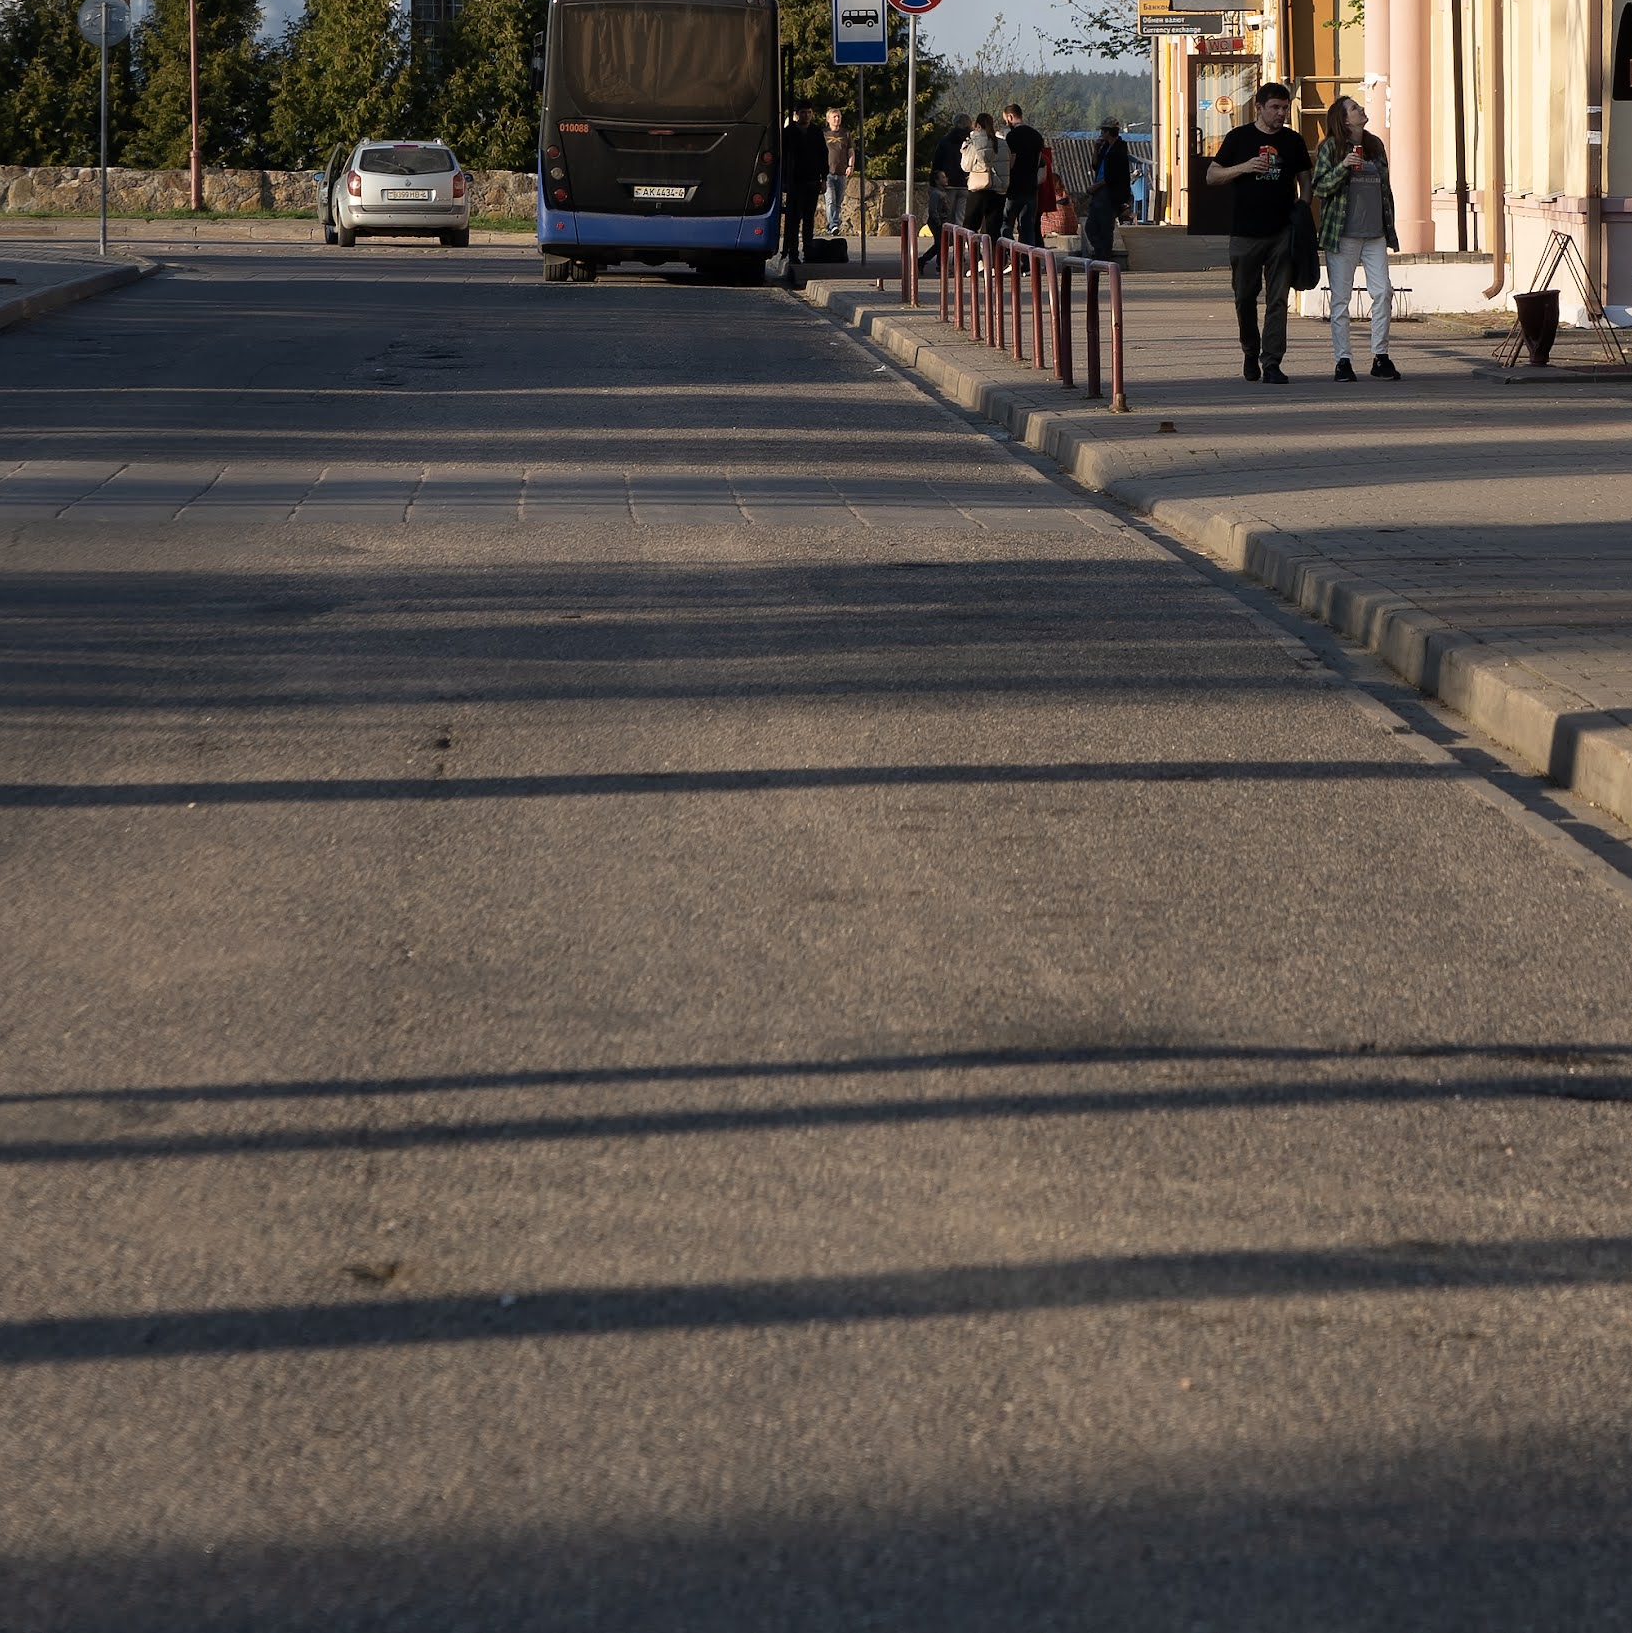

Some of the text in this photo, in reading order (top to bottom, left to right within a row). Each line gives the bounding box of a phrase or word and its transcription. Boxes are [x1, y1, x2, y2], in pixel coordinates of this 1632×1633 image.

[1142, 16, 1185, 24] Обмен валют
[1142, 26, 1201, 34] Currency exchange
[1209, 41, 1228, 51] WC
